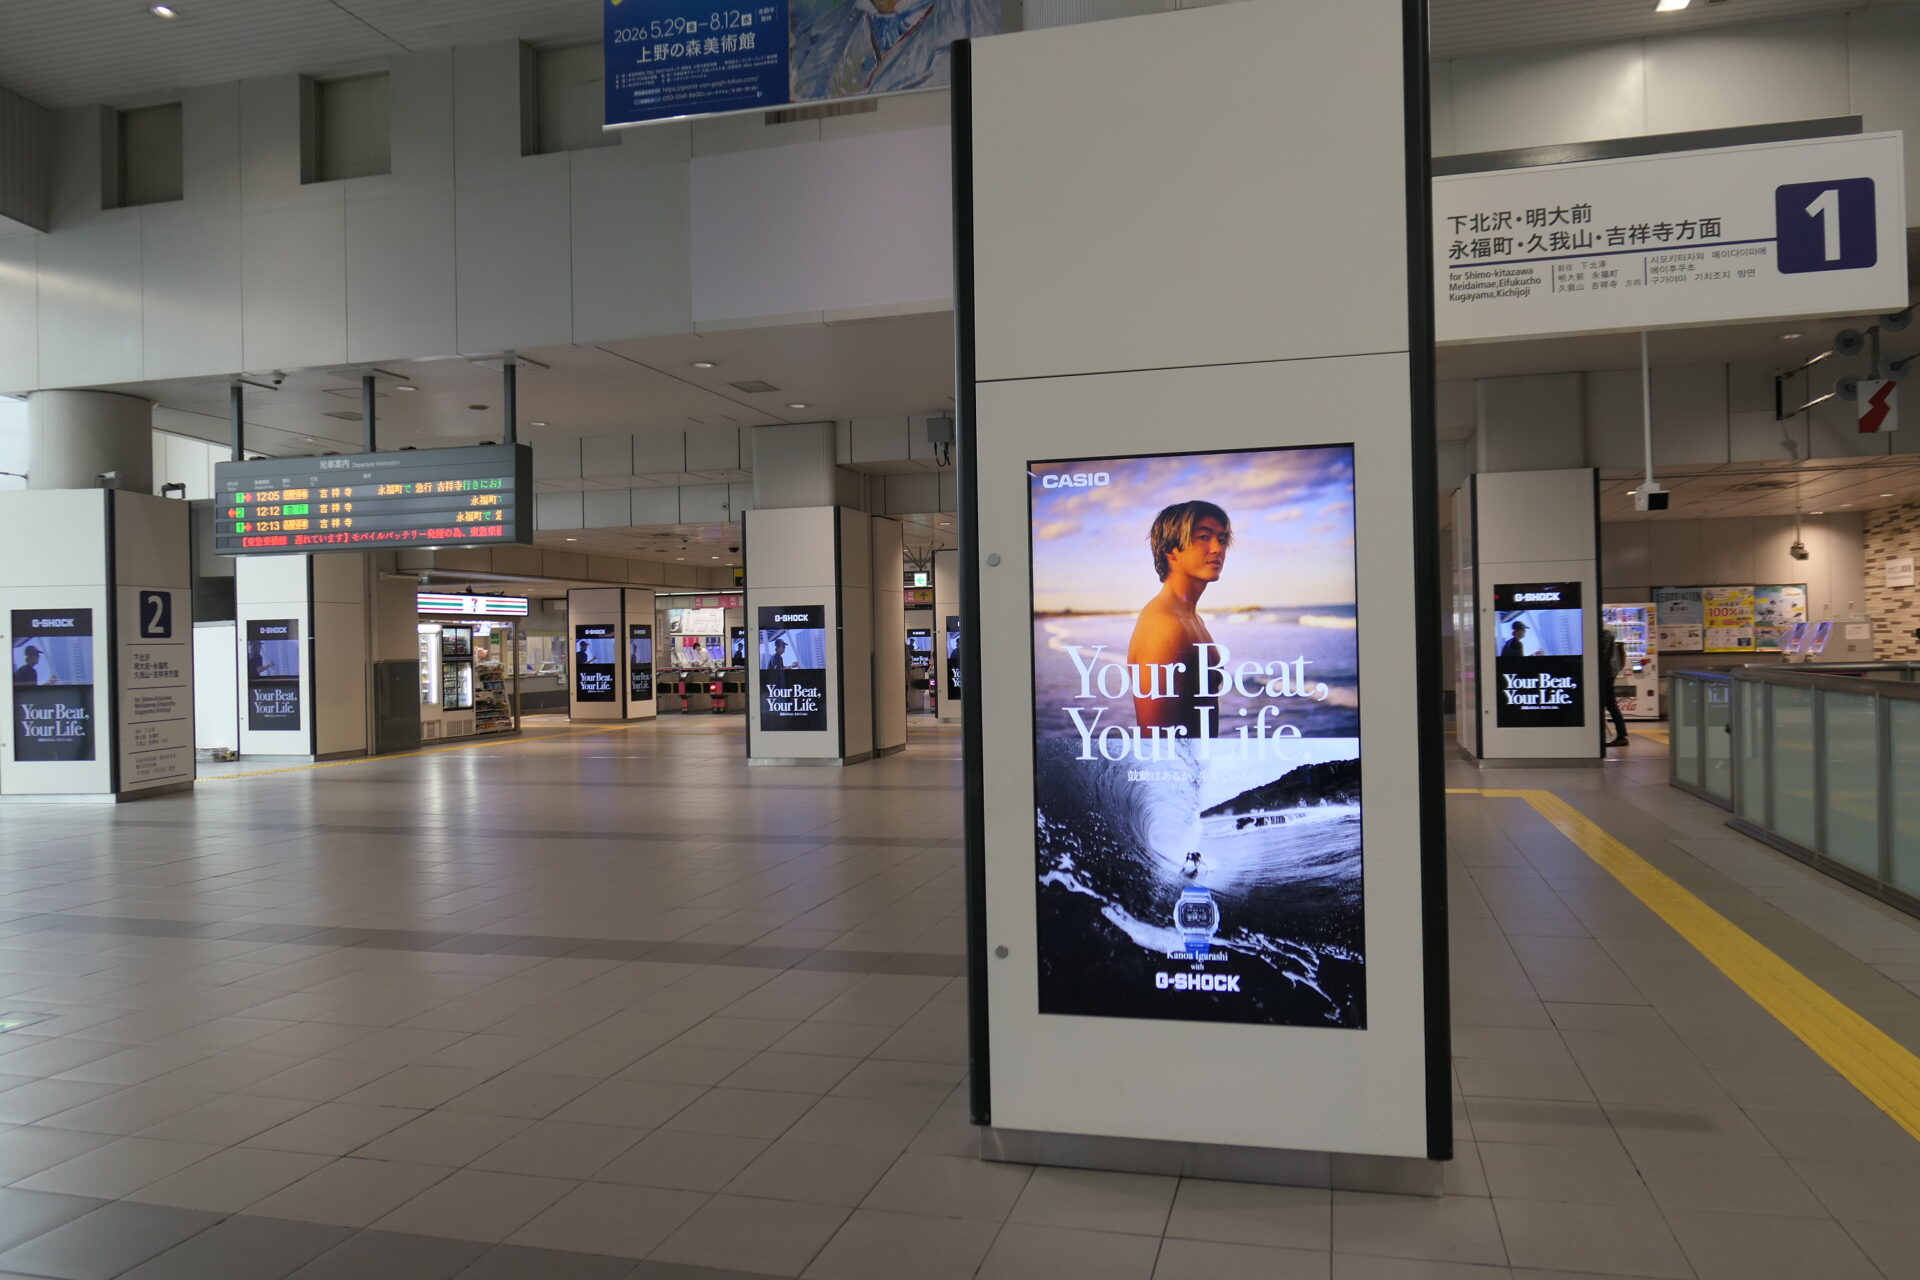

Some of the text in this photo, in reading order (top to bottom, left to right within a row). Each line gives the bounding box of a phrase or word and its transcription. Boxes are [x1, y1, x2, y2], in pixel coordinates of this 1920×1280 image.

[614, 28, 648, 43] 2026
[636, 32, 756, 64] 上野の森美術館
[1447, 203, 1593, 235] 下北沢・明大前
[1805, 189, 1841, 261] 1
[1448, 217, 1722, 260] 永福町・久我山・吉祥寺方面
[1449, 268, 1534, 281] for Shimo-kitazawa
[1042, 471, 1110, 489] CASIO
[256, 492, 280, 502] 12:05
[256, 507, 280, 517] 12:12
[256, 521, 280, 531] 12:13
[1514, 592, 1561, 602] G-SHOCK
[148, 595, 164, 634] 2
[774, 613, 809, 622] G-SHOCK
[32, 618, 75, 628] G-SHOCK
[580, 672, 596, 682] Your
[1061, 642, 1330, 702] Your Beat,
[580, 681, 596, 690] Your
[1503, 673, 1577, 688] Your Beat,
[254, 689, 298, 701] Your Beat,
[766, 684, 821, 698] Your Beat,
[1504, 689, 1573, 705] Your Life.
[21, 703, 90, 720] Your Beat,
[254, 701, 296, 713] Your Life.
[767, 698, 818, 712] Your Life.
[21, 721, 86, 738] Your Life.
[1062, 704, 1313, 762] Your Life.
[1166, 950, 1228, 962] Kanoa Igarashi
[1190, 963, 1205, 971] with
[1156, 971, 1241, 992] G-SHOCK
